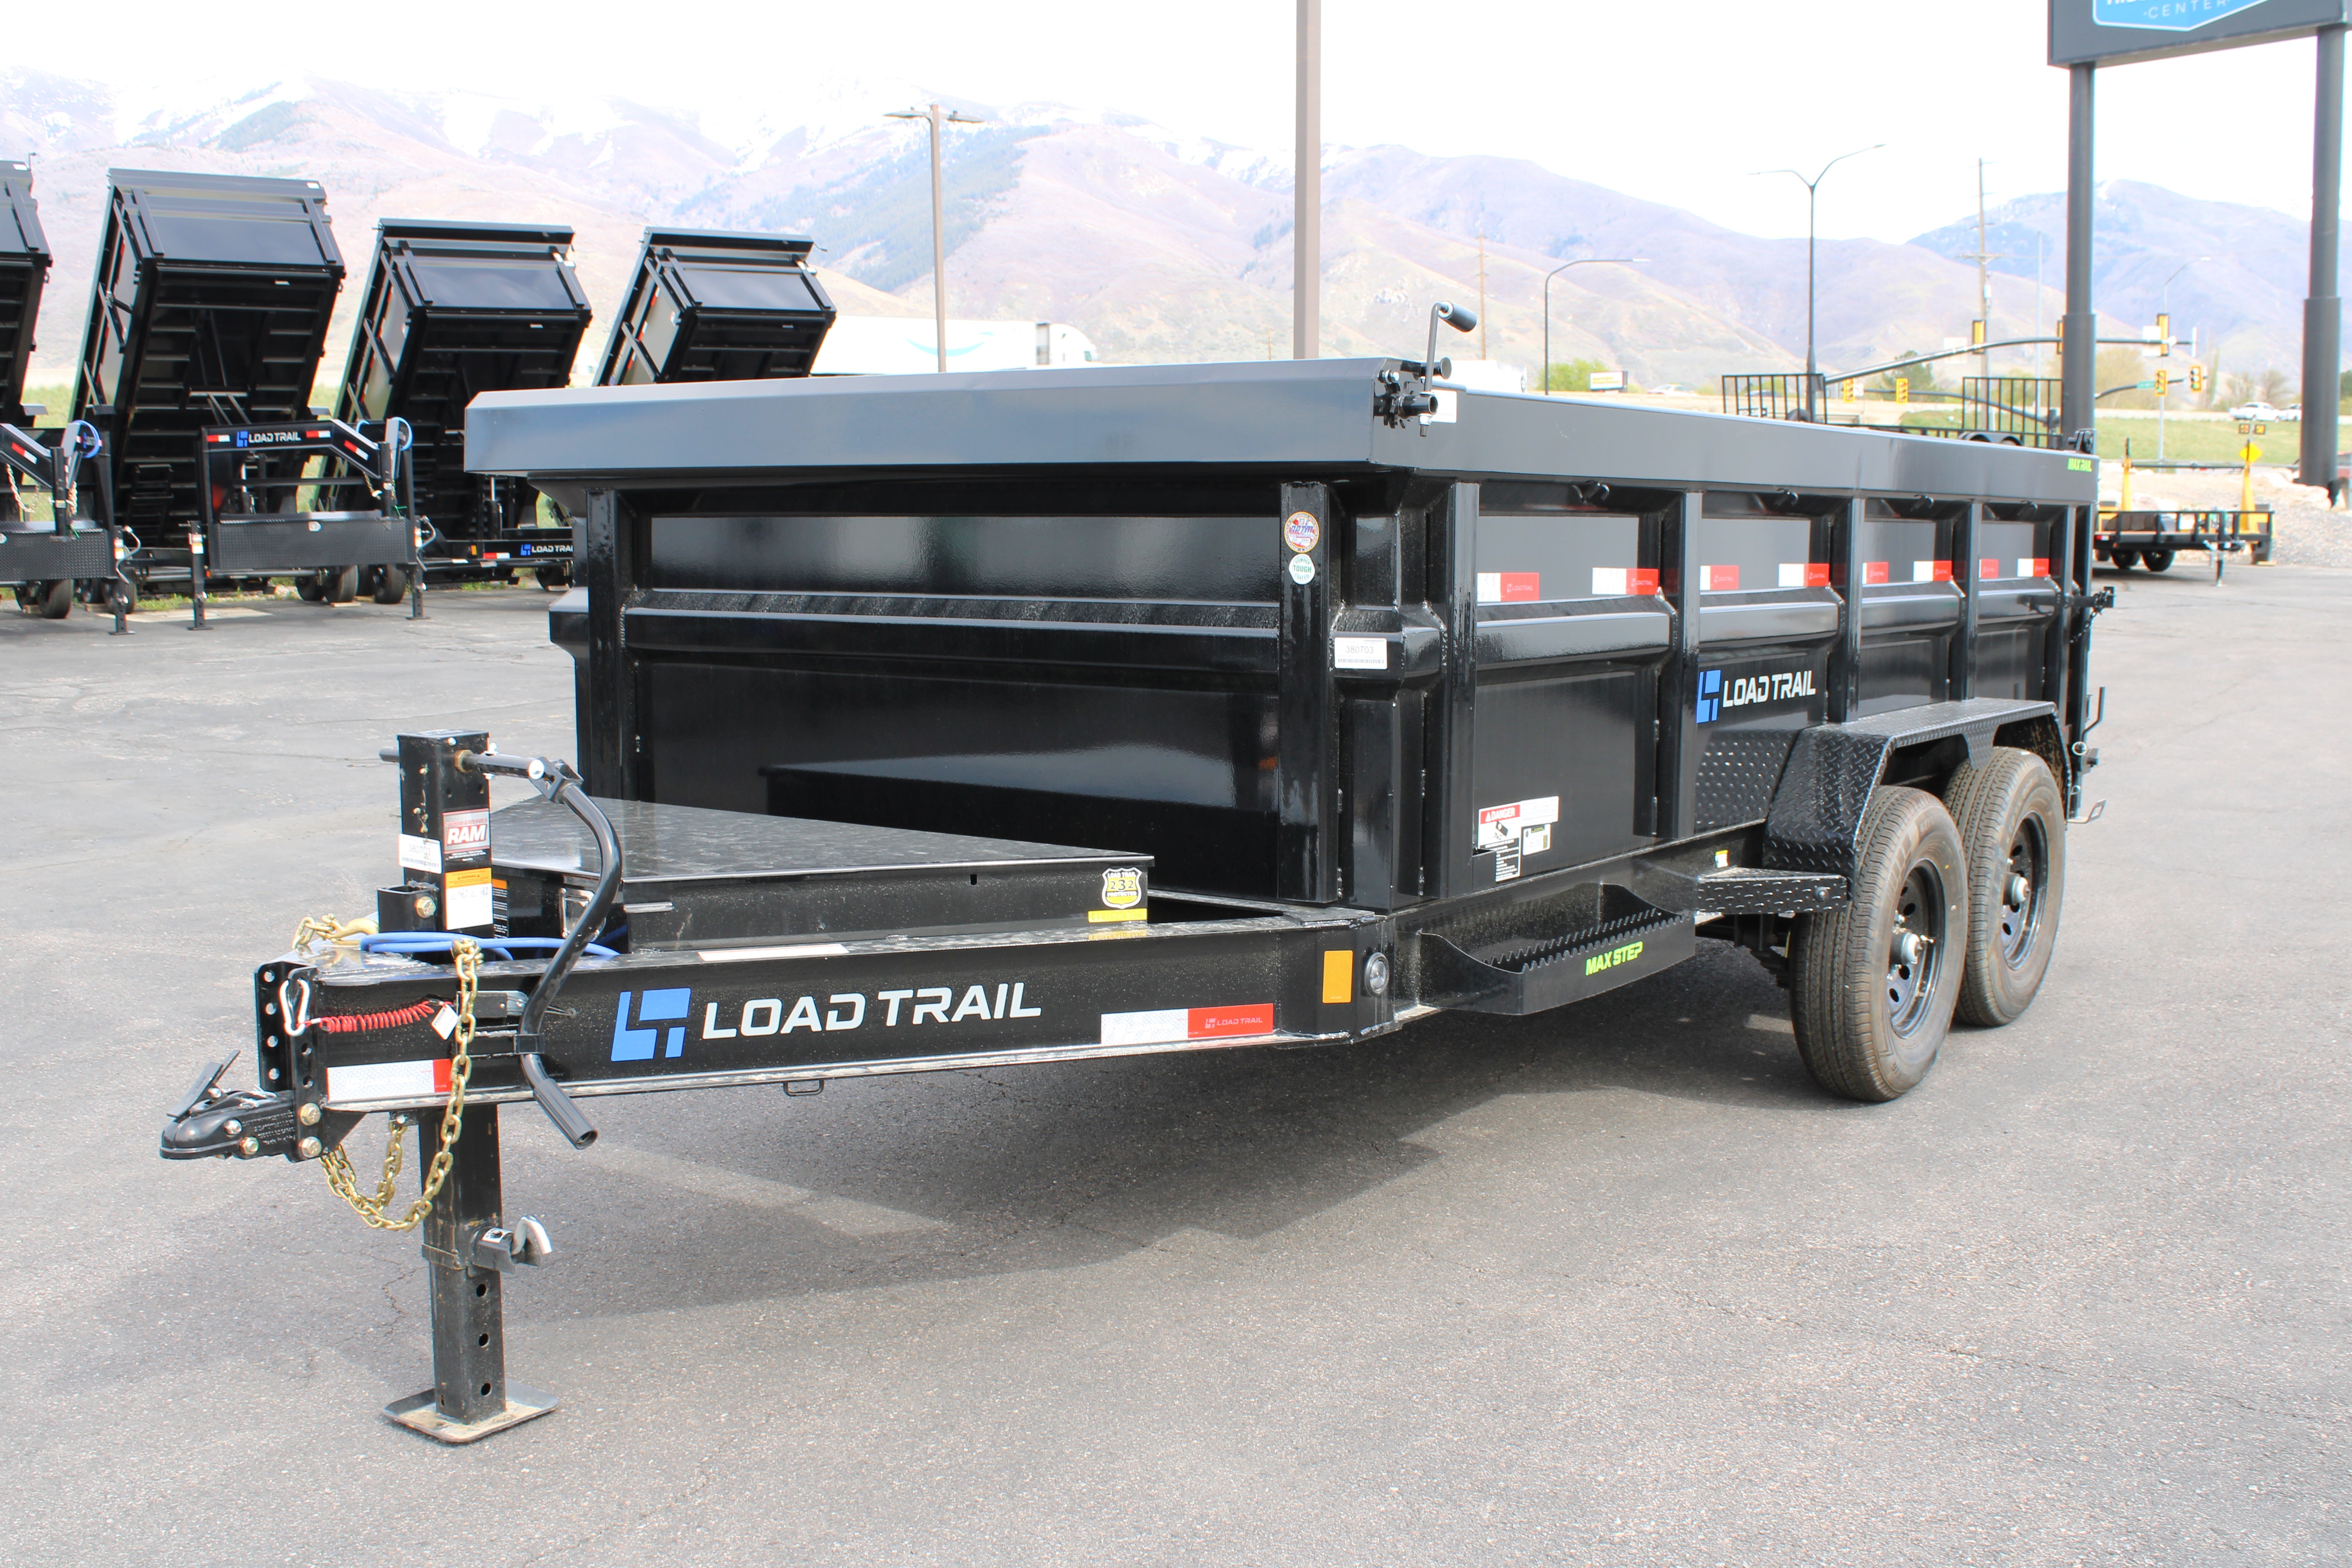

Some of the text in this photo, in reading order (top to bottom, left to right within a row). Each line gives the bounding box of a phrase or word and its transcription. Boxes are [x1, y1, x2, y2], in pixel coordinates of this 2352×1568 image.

[248, 431, 301, 443] LOAD TRAIL
[1293, 565, 1312, 573] TOUGH
[1722, 670, 1816, 708] LOAD TRAIL
[1491, 807, 1515, 821] DANGER
[447, 824, 487, 845] RAM
[408, 844, 431, 856] 380703
[1585, 940, 1644, 976] MAX STEP
[702, 982, 1042, 1040] LOAD TRAIL
